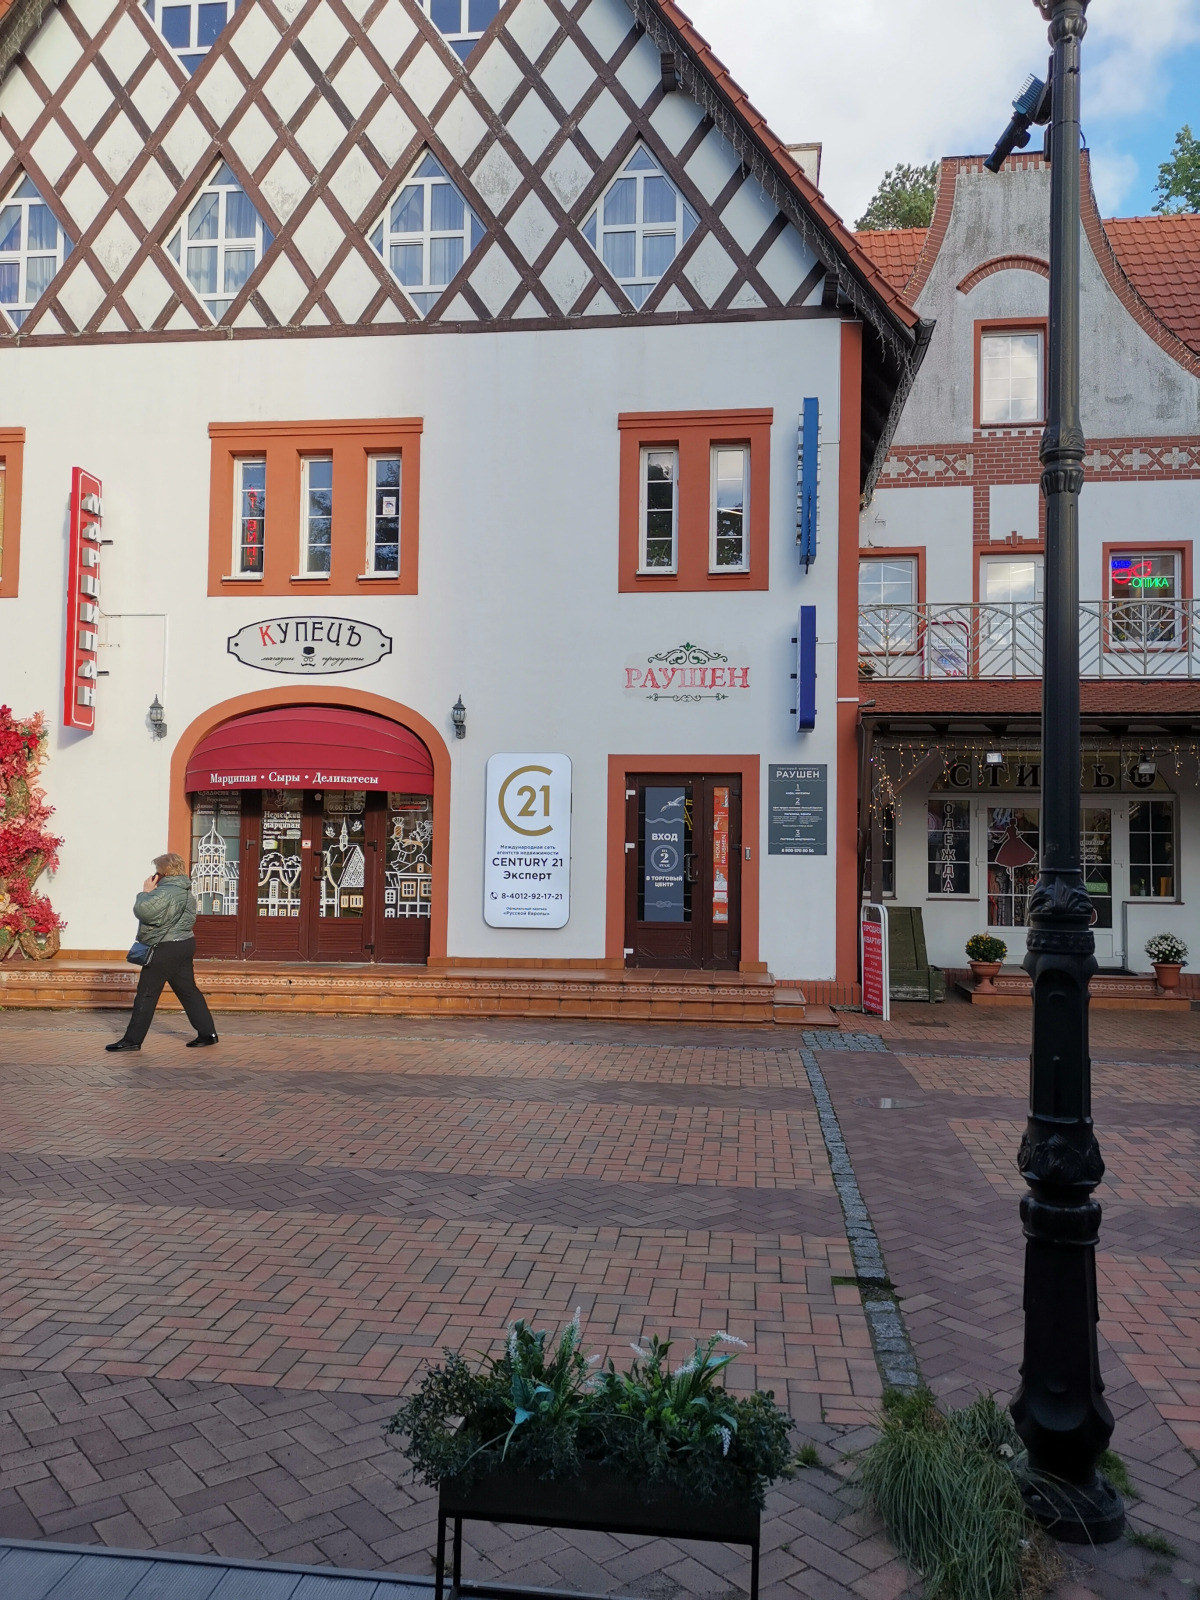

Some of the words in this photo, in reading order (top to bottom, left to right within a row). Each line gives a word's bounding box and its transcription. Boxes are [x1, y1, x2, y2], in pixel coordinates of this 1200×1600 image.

[1132, 577, 1170, 588] ОПТИКА
[258, 621, 362, 647] КУПЕЦЪ
[624, 667, 750, 689] РАУШЕН
[210, 773, 257, 786] Марципан
[268, 772, 300, 785] Сыры
[312, 772, 379, 784] Деликатесы
[776, 770, 820, 778] РАУШЕН
[949, 763, 1115, 788] СТИЬ
[651, 833, 679, 842] ВХОД
[941, 802, 956, 891] ОДЕЖДА
[492, 857, 548, 867] CENTURY
[551, 857, 563, 867] 21
[660, 852, 669, 864] 2
[503, 871, 552, 881] Эксперт
[501, 892, 563, 900] 8-4012-92-17-21
